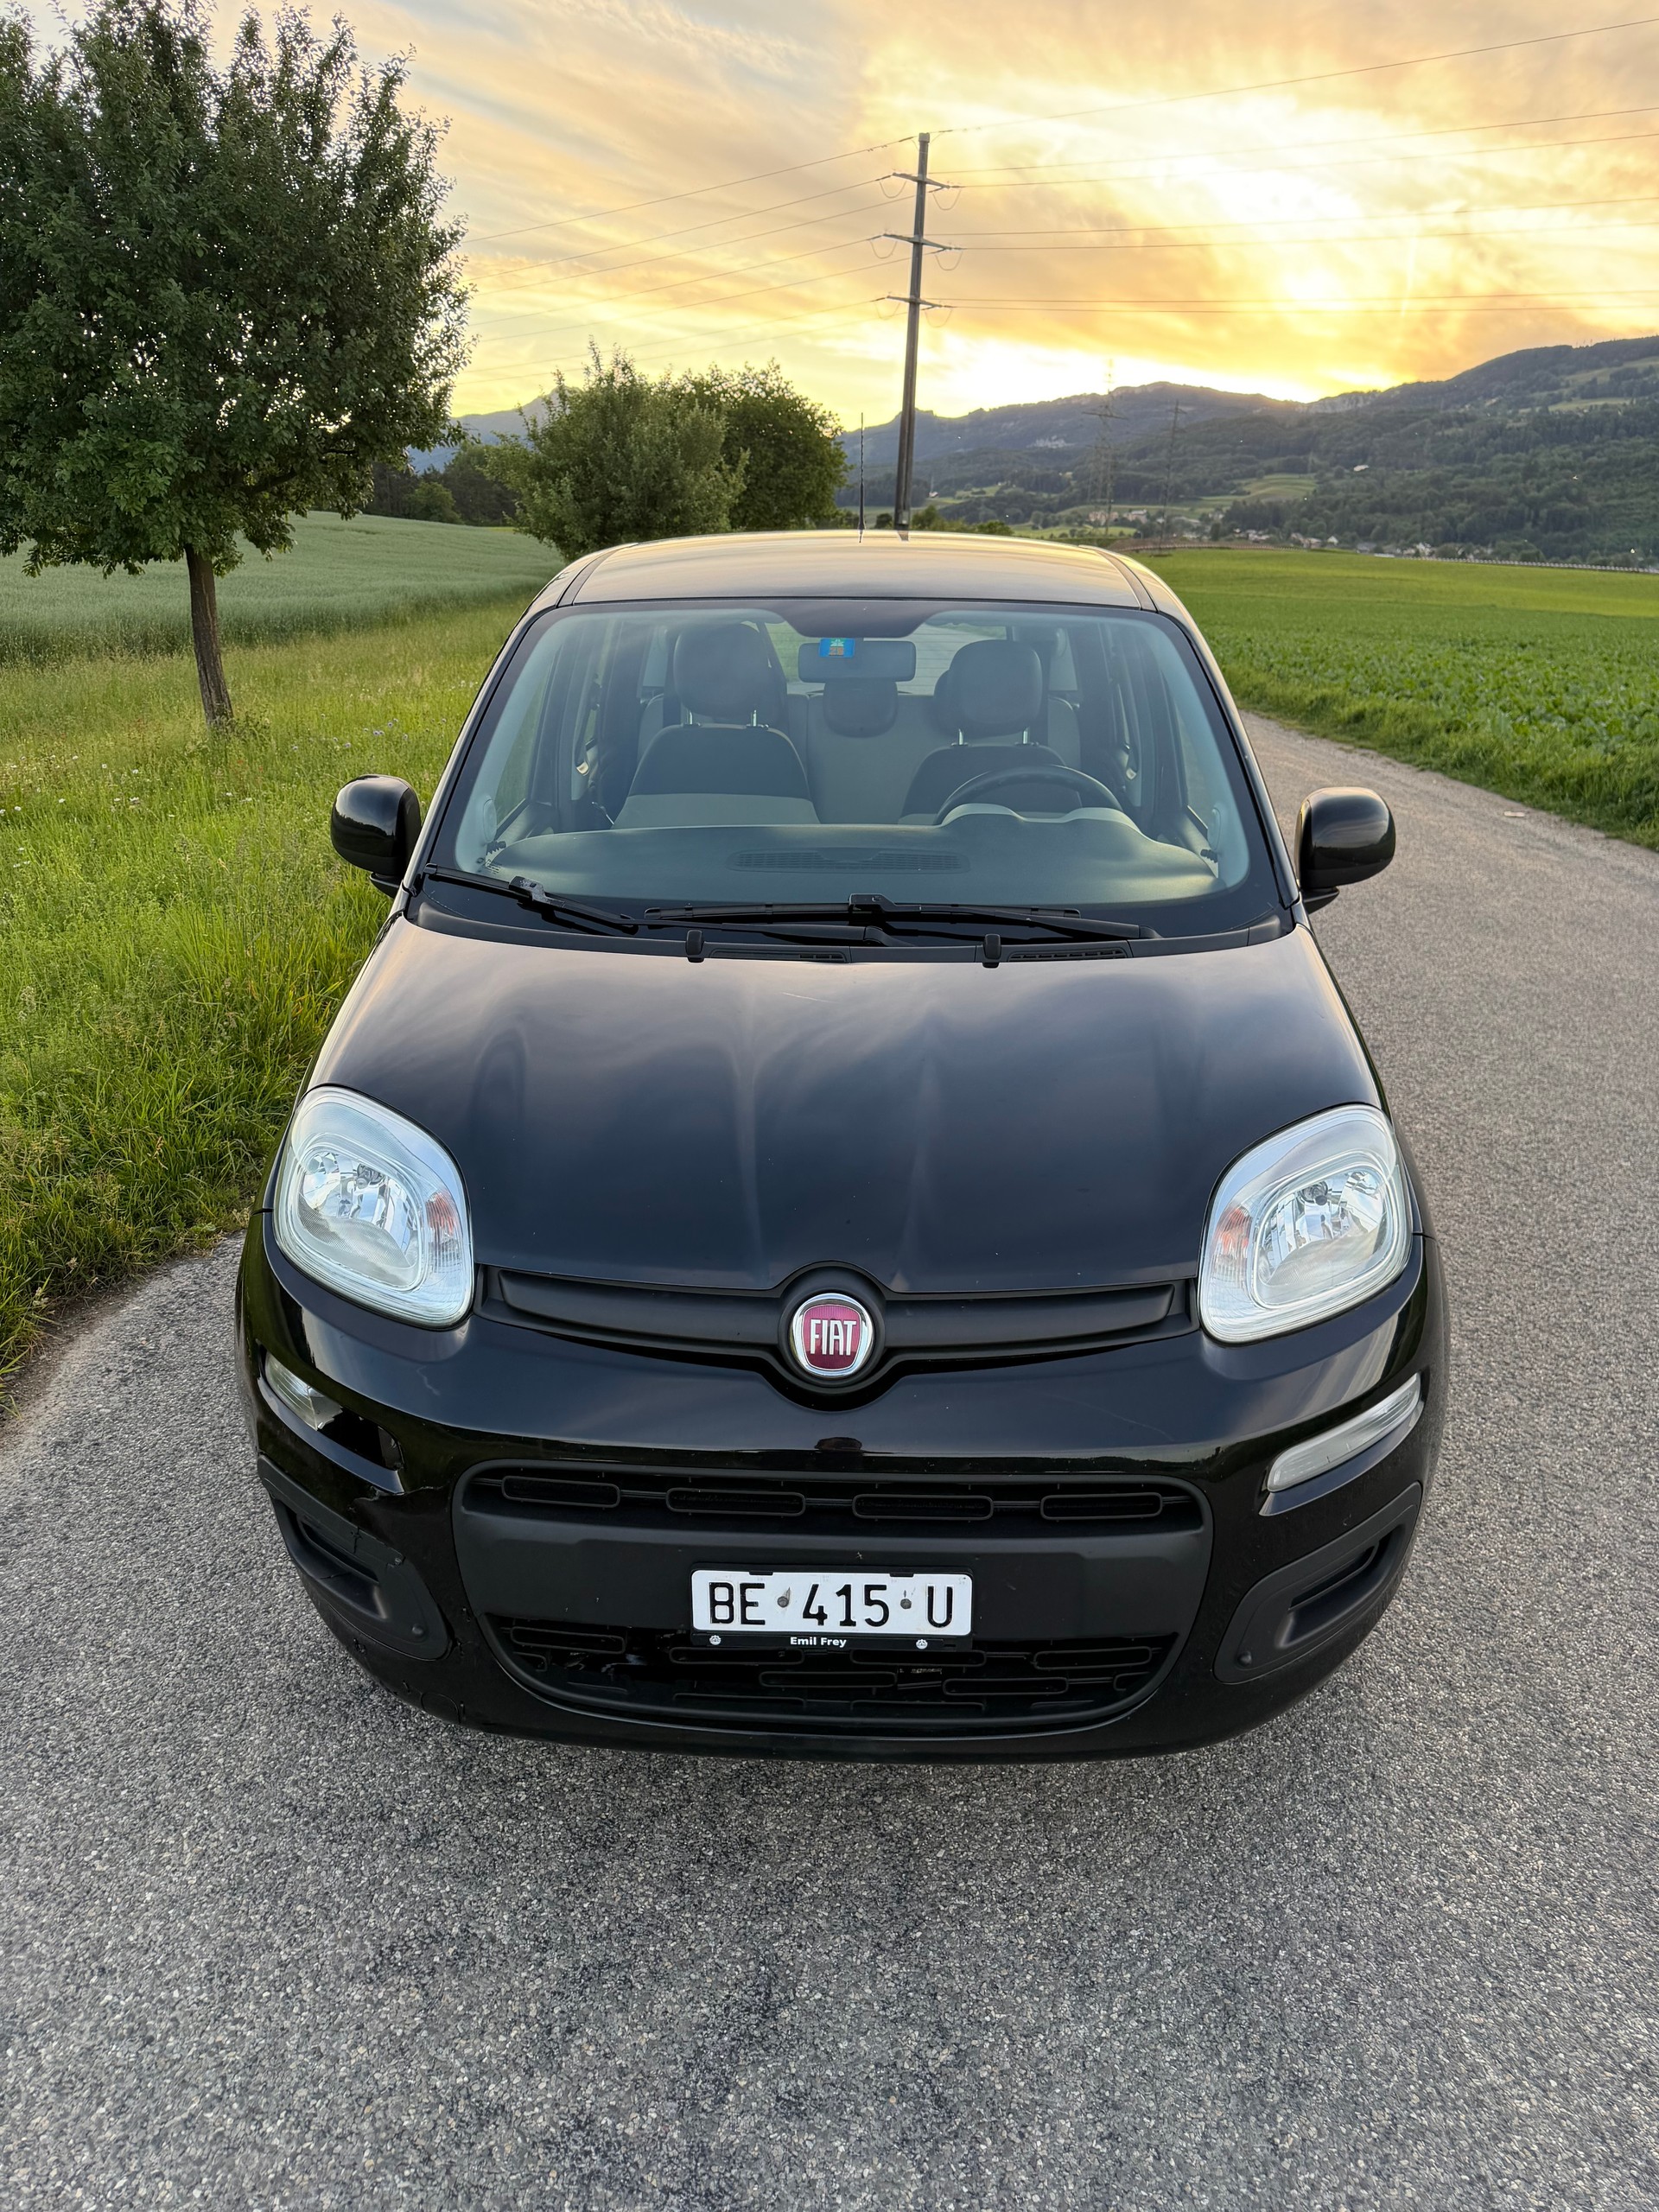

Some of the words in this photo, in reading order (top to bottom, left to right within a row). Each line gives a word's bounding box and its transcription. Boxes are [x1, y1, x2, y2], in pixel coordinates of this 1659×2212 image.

[810, 1319, 857, 1356] FIAT
[709, 1582, 766, 1625] BE
[802, 1583, 890, 1627] 415
[927, 1586, 953, 1628] U
[790, 1637, 817, 1646] Emil
[820, 1637, 847, 1649] Frey
